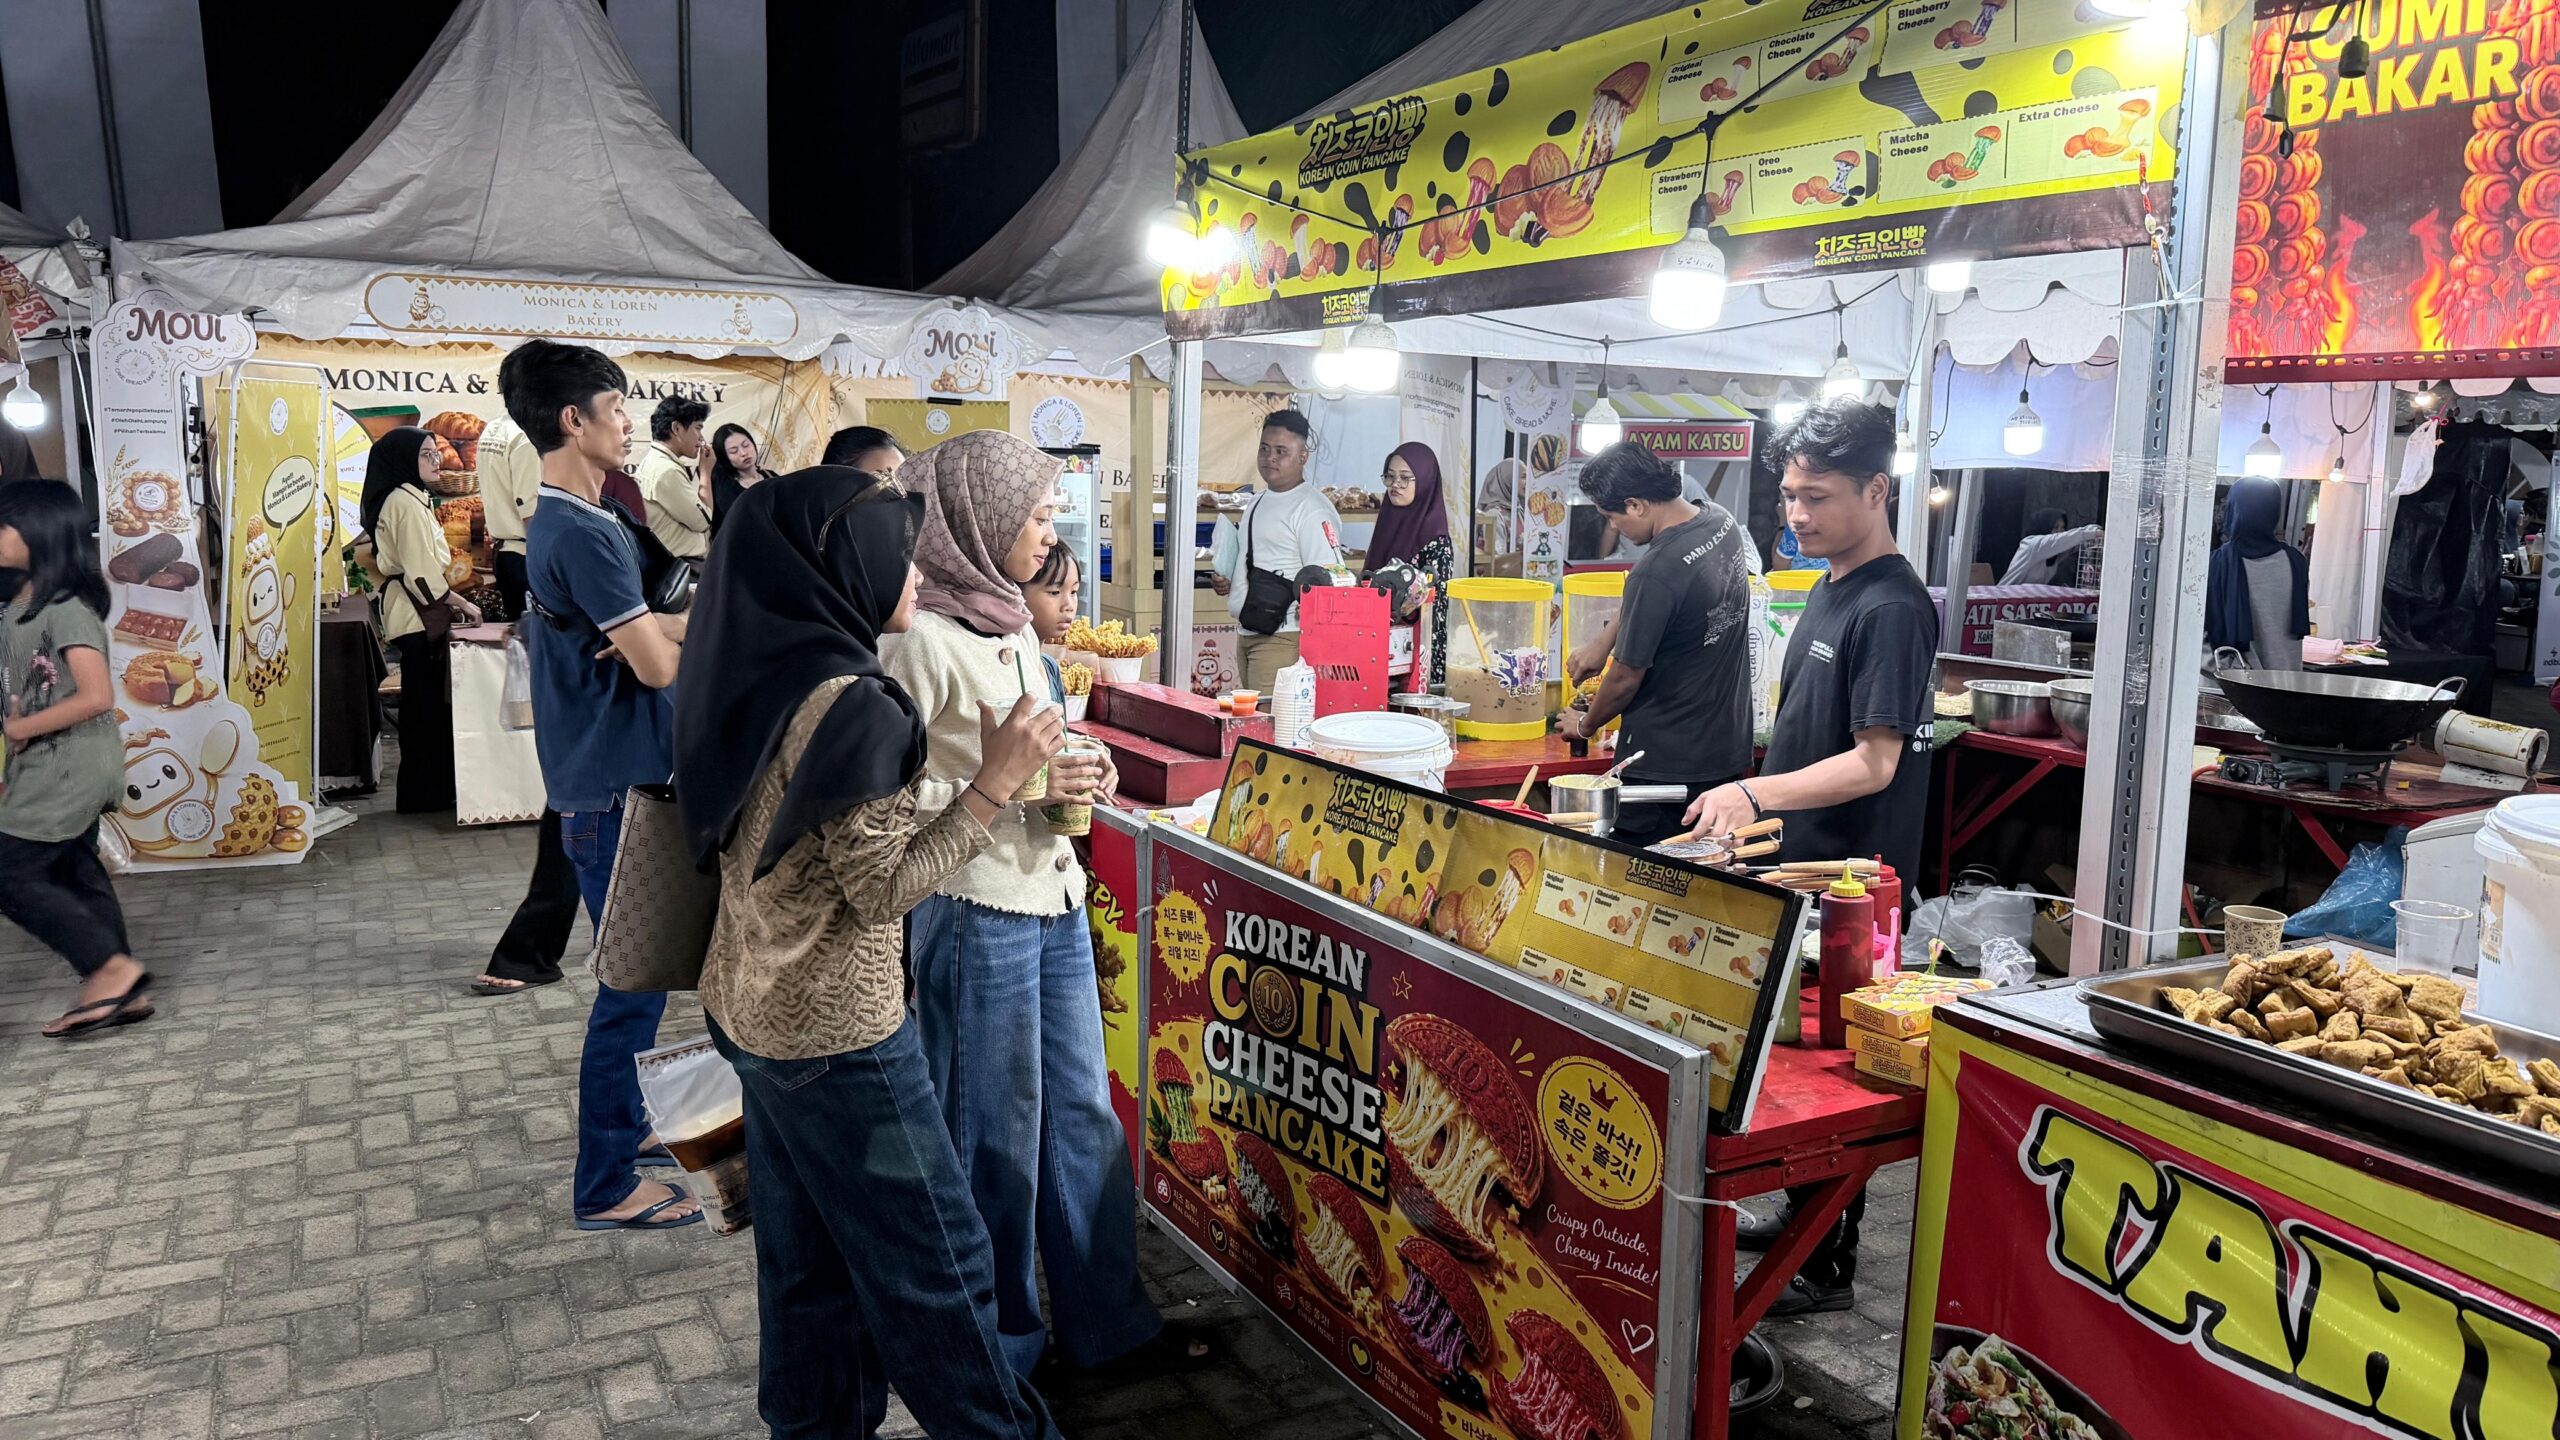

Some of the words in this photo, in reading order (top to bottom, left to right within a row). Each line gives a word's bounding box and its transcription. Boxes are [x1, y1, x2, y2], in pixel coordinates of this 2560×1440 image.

[1897, 0, 1951, 19] Blueberry
[1896, 16, 1936, 31] Cheese
[1768, 31, 1816, 49] Chocolate
[1767, 46, 1802, 60] Cheese
[1671, 59, 1703, 73] Original
[2288, 38, 2520, 127] BAKAR
[2018, 109, 2050, 123] Extra
[2053, 102, 2100, 118] Cheese
[1301, 98, 1426, 170] 치즈코인빵
[1889, 131, 1930, 145] Matcha
[1758, 156, 1780, 167] Oreo
[1889, 144, 1929, 158] Cheese
[1299, 164, 1335, 186] KOREAN
[1336, 159, 1361, 175] COIN
[1361, 146, 1410, 170] PANCAKE
[1658, 169, 1703, 184] Strawberry
[1758, 166, 1793, 178] Cheese
[1657, 184, 1688, 195] Cheese
[1814, 225, 1927, 259] 치즈코인빵
[1814, 254, 1852, 267] KOREAN
[1854, 252, 1879, 264] COIN
[1880, 247, 1927, 260] PANCAKE
[523, 295, 587, 309] MONICA
[592, 298, 603, 310] &
[611, 300, 658, 312] LOREN
[567, 314, 624, 327] BAKERY
[325, 368, 459, 394] MONICA
[467, 374, 490, 395] &
[630, 376, 728, 403] AKERY
[1033, 399, 1058, 420] MONICA
[1064, 400, 1084, 423] LOREN
[1688, 431, 1746, 451] KATSU
[1328, 773, 1407, 830] 치즈코인빵
[1325, 810, 1350, 827] KOREAN
[1349, 818, 1366, 833] COIN
[1366, 823, 1399, 844] PANCAKE
[1224, 909, 1367, 992] KOREAN
[1202, 1019, 1382, 1145] CHEESE
[1210, 1074, 1387, 1200] PANCAKE
[1596, 1117, 1643, 1163] 바삭!
[1546, 1202, 1588, 1238] Crispy
[1592, 1218, 1650, 1256] Outside,
[1555, 1233, 1601, 1271] Cheesy
[1601, 1250, 1659, 1287] Inside!
